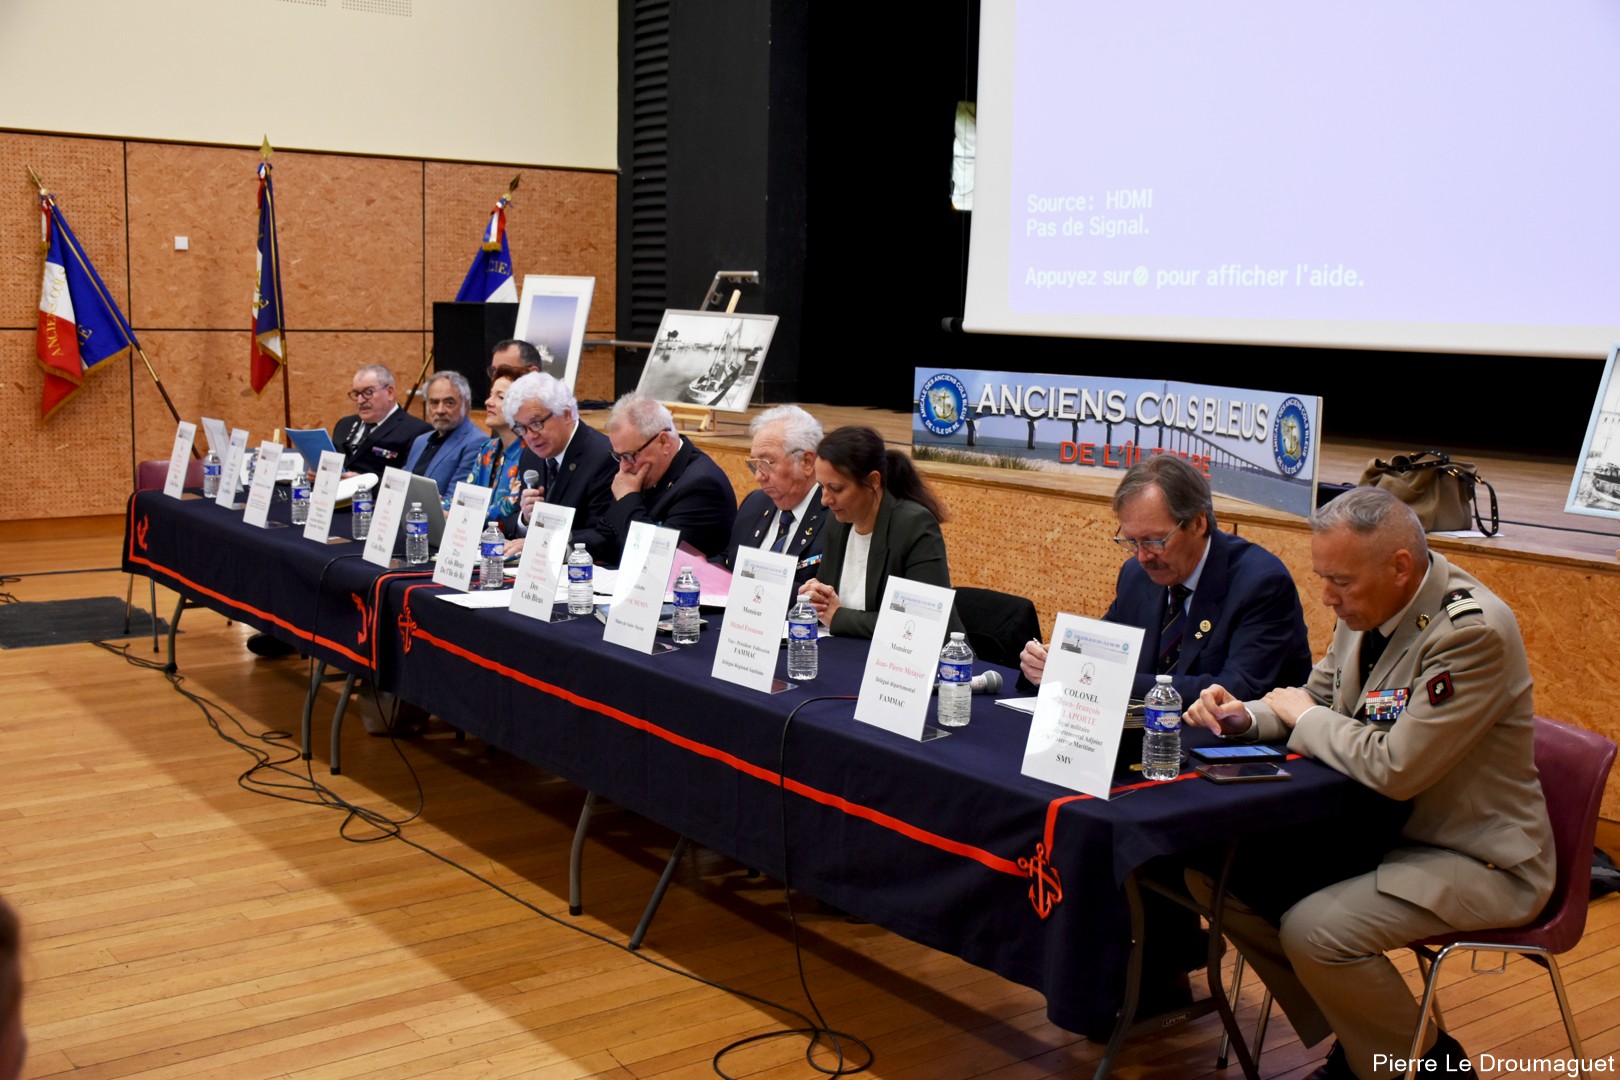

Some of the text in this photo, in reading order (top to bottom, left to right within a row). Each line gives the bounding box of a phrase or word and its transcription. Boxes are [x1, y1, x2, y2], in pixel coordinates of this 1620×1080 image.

[1027, 188, 1153, 213] Source: HDMI
[1026, 213, 1149, 238] Pas de Signal.
[1024, 267, 1098, 290] Appuyez
[1156, 268, 1200, 289] pour
[1206, 263, 1289, 287] afficher
[1296, 263, 1364, 287] l'aide.
[975, 383, 1270, 442] ANCIENS COLS BLEUS
[1060, 441, 1096, 465] DE
[743, 606, 762, 616] Monsieur
[734, 647, 756, 659] FAMMAC
[891, 642, 913, 655] Monsieur
[879, 694, 906, 708] FAMMAC
[1064, 688, 1099, 704] COLONEL
[1075, 702, 1100, 715] françois
[1062, 710, 1096, 726] LAPORTE
[1073, 740, 1095, 753] Maritime
[1056, 754, 1073, 764] SMV
